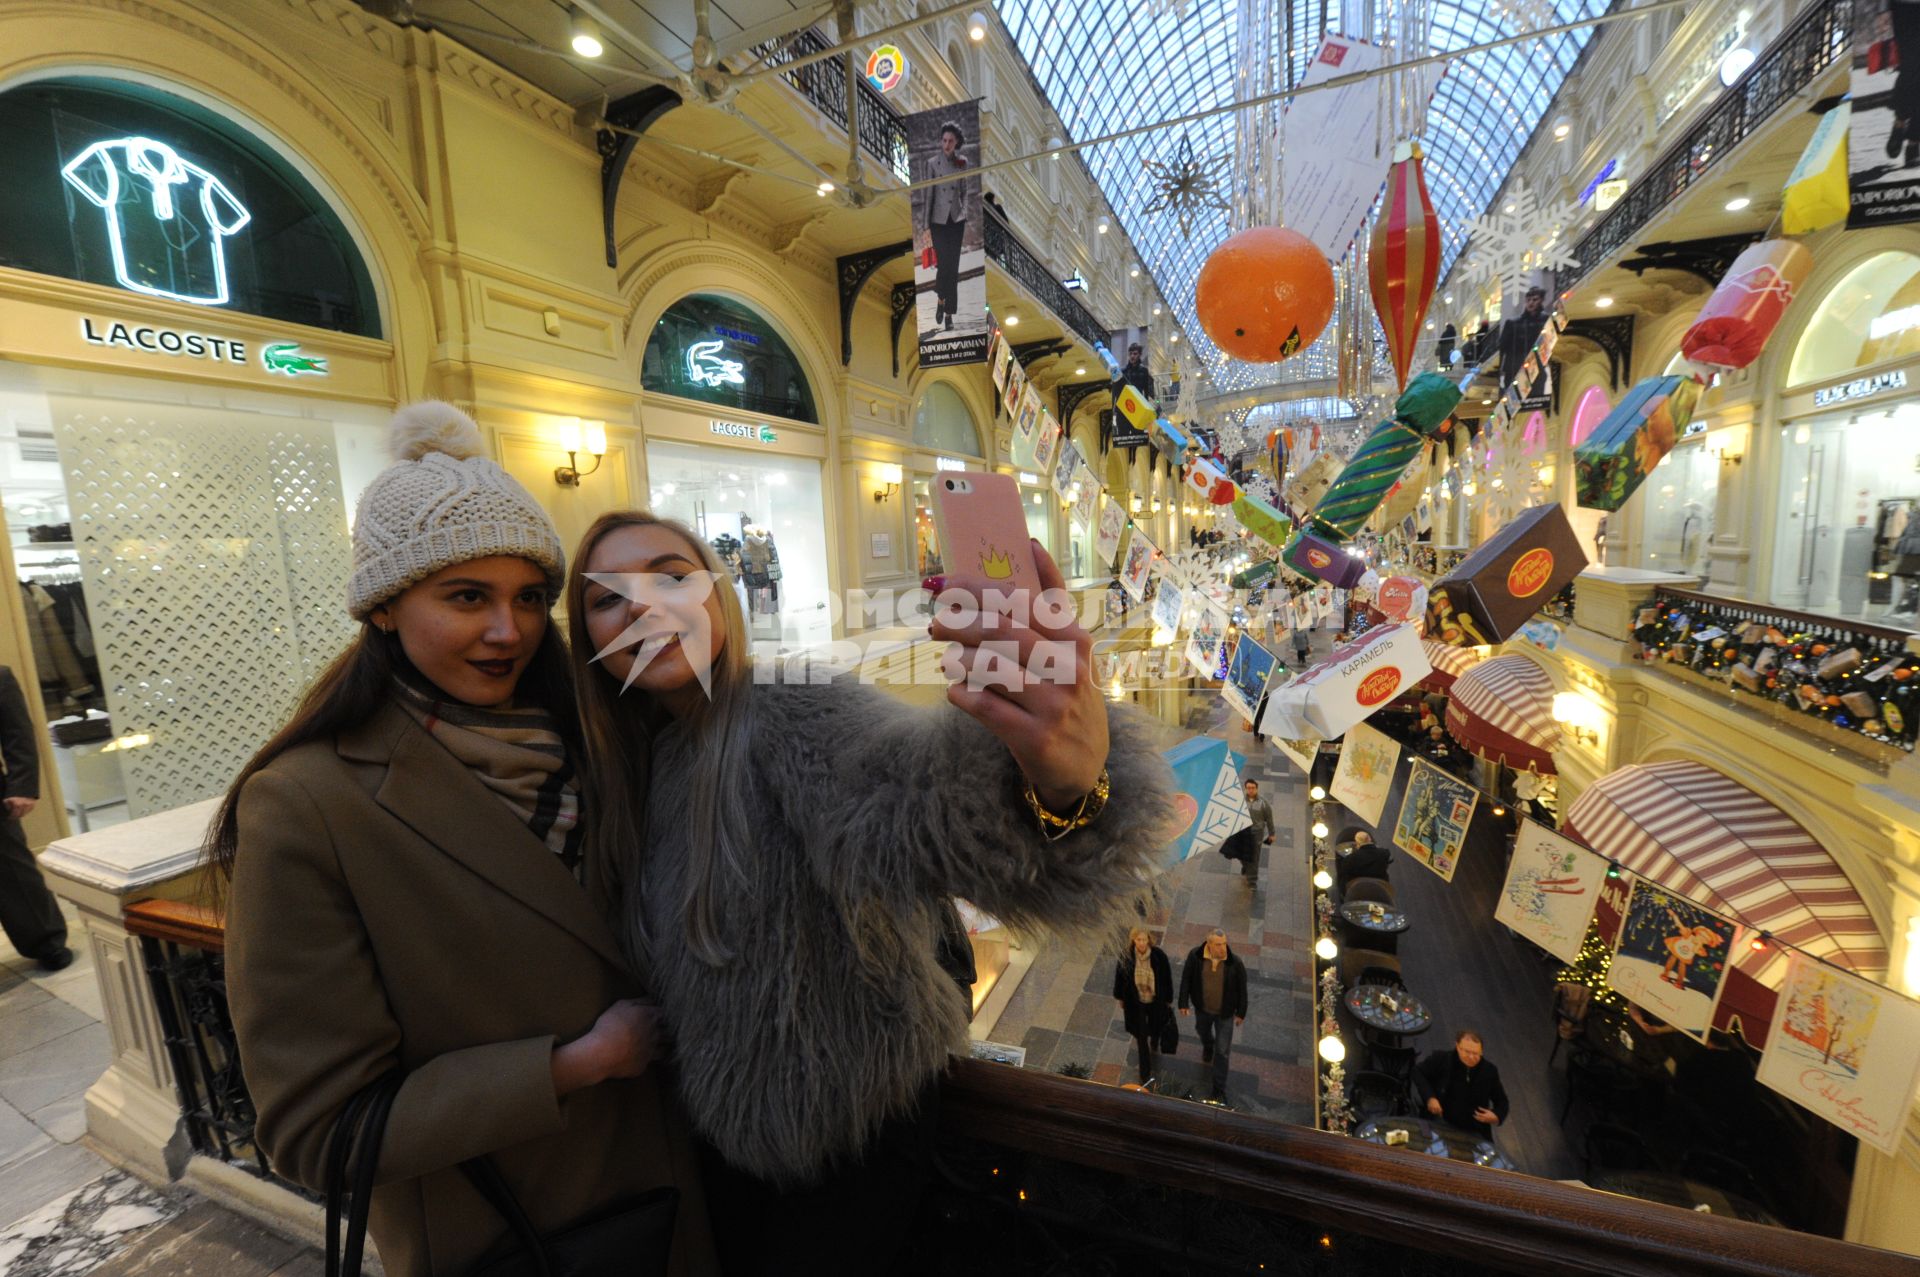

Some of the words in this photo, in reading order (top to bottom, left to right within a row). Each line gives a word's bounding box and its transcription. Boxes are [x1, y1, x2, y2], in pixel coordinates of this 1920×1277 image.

[83, 318, 247, 363] LACOSTE
[711, 420, 755, 438] LACOSTE
[1341, 641, 1393, 677] КАРАМЕЛЬ
